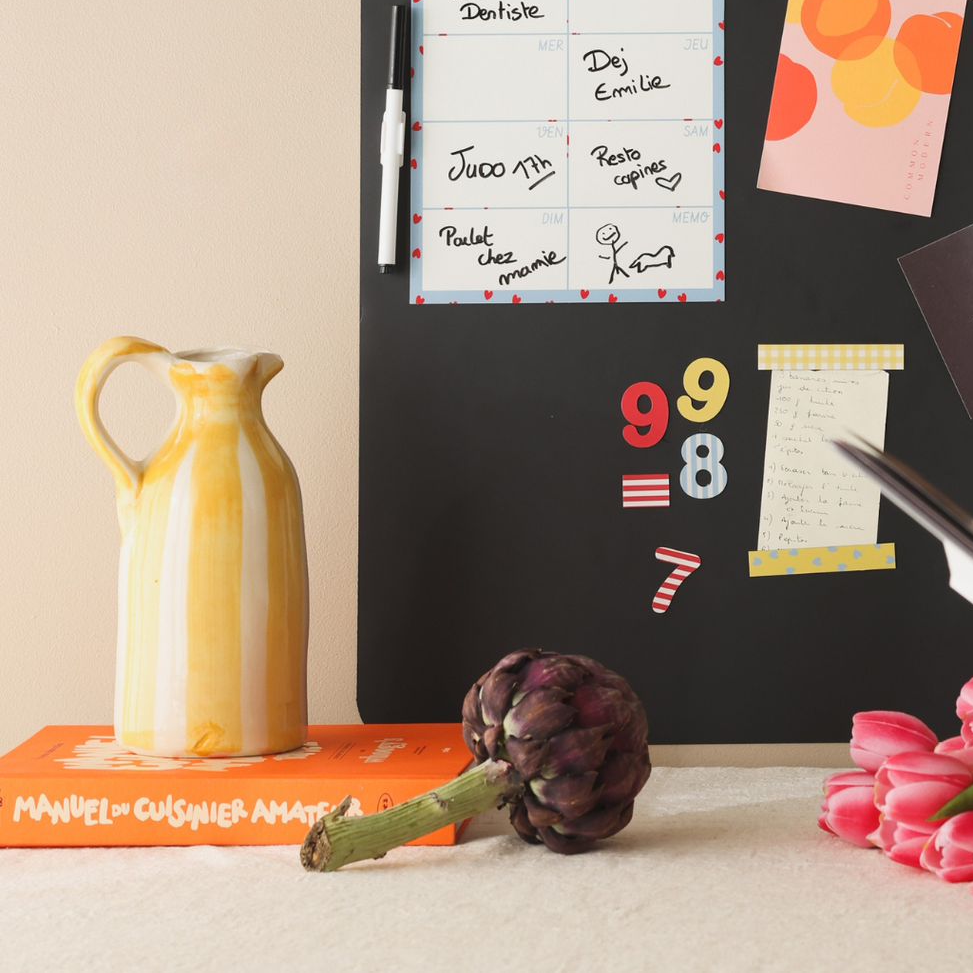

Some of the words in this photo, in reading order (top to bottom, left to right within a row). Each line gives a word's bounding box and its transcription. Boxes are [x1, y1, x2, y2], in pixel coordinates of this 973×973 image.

[459, 1, 545, 21] Dentiste
[537, 40, 564, 51] MER
[683, 38, 709, 50] JEU
[583, 47, 628, 76] Dej
[594, 74, 671, 101] Emilie
[536, 126, 564, 138] VEN
[683, 125, 709, 137] SAM
[590, 145, 641, 167] Resto
[918, 120, 933, 181] MODERN
[904, 139, 920, 200] COMMON
[542, 212, 564, 224] DIM
[672, 211, 710, 224] MEMO
[478, 248, 517, 266] chez
[498, 250, 567, 285] mamie
[13, 793, 113, 826] MANUEL
[112, 802, 130, 818] DU
[134, 794, 248, 831] CUISINIER
[251, 798, 363, 828] AMATER
